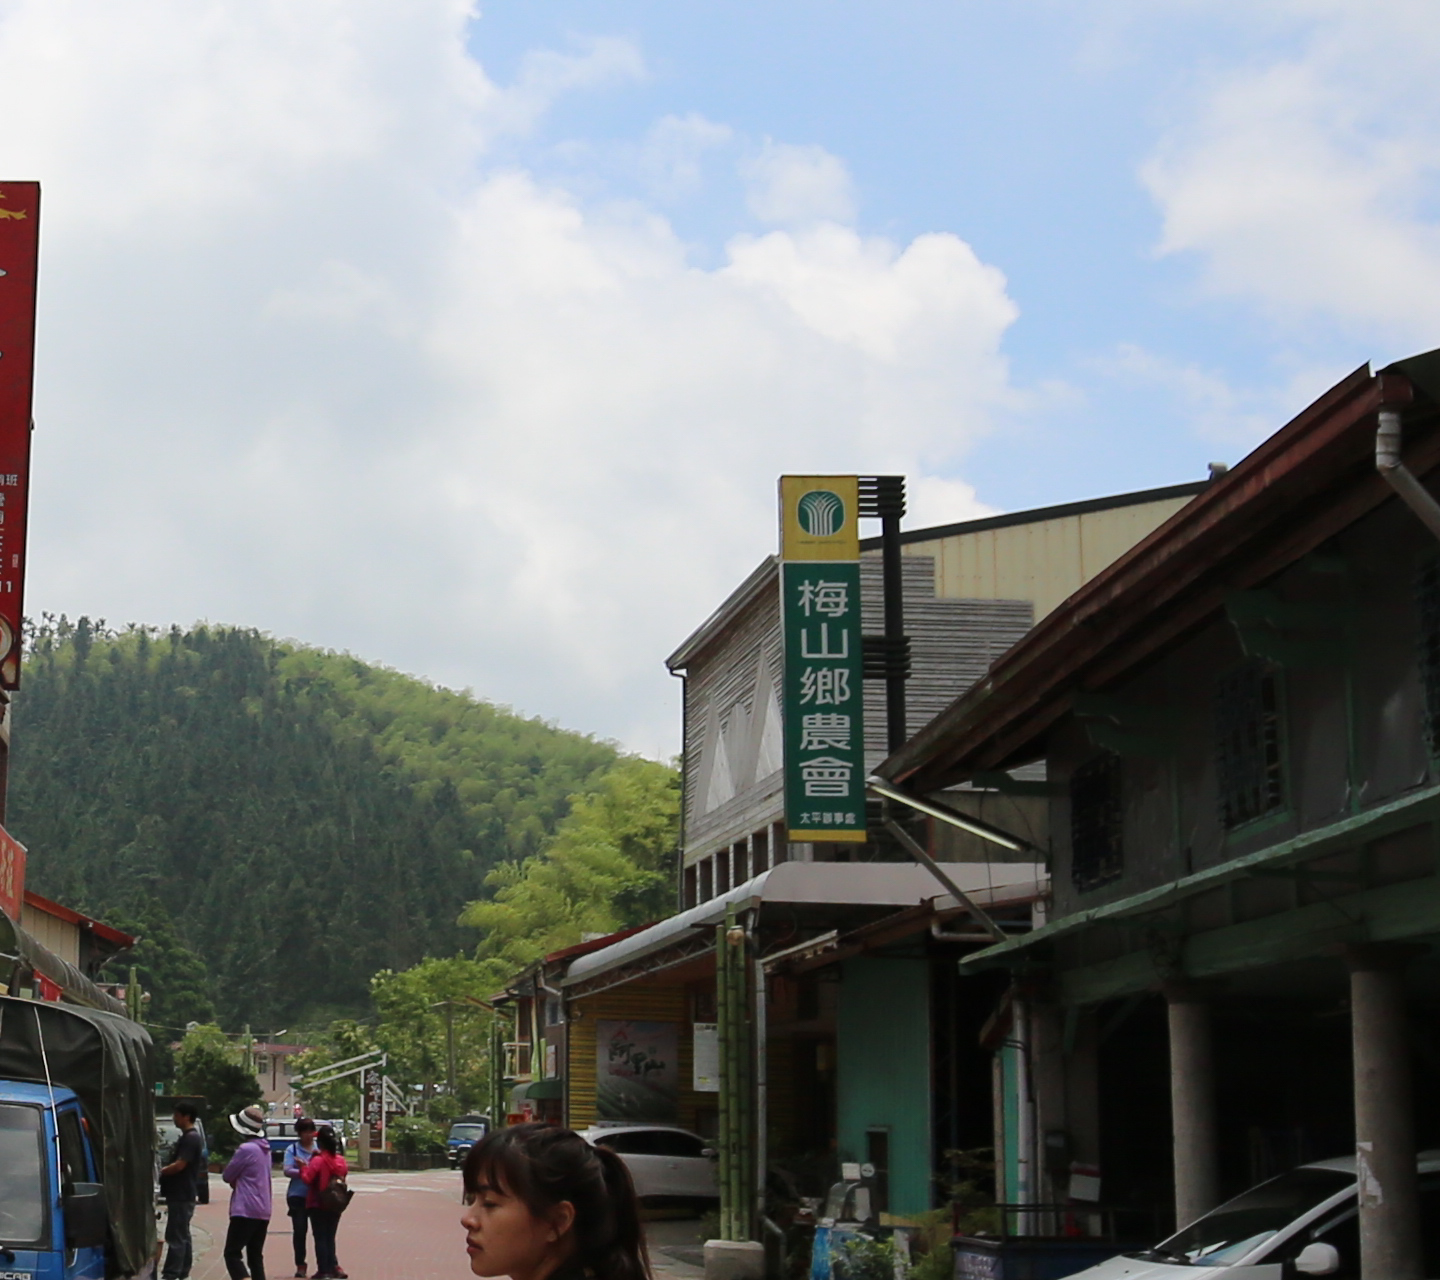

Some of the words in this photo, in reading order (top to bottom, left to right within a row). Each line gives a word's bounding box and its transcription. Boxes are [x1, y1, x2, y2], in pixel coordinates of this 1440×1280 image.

[798, 580, 853, 797] 梅山鄉農會
